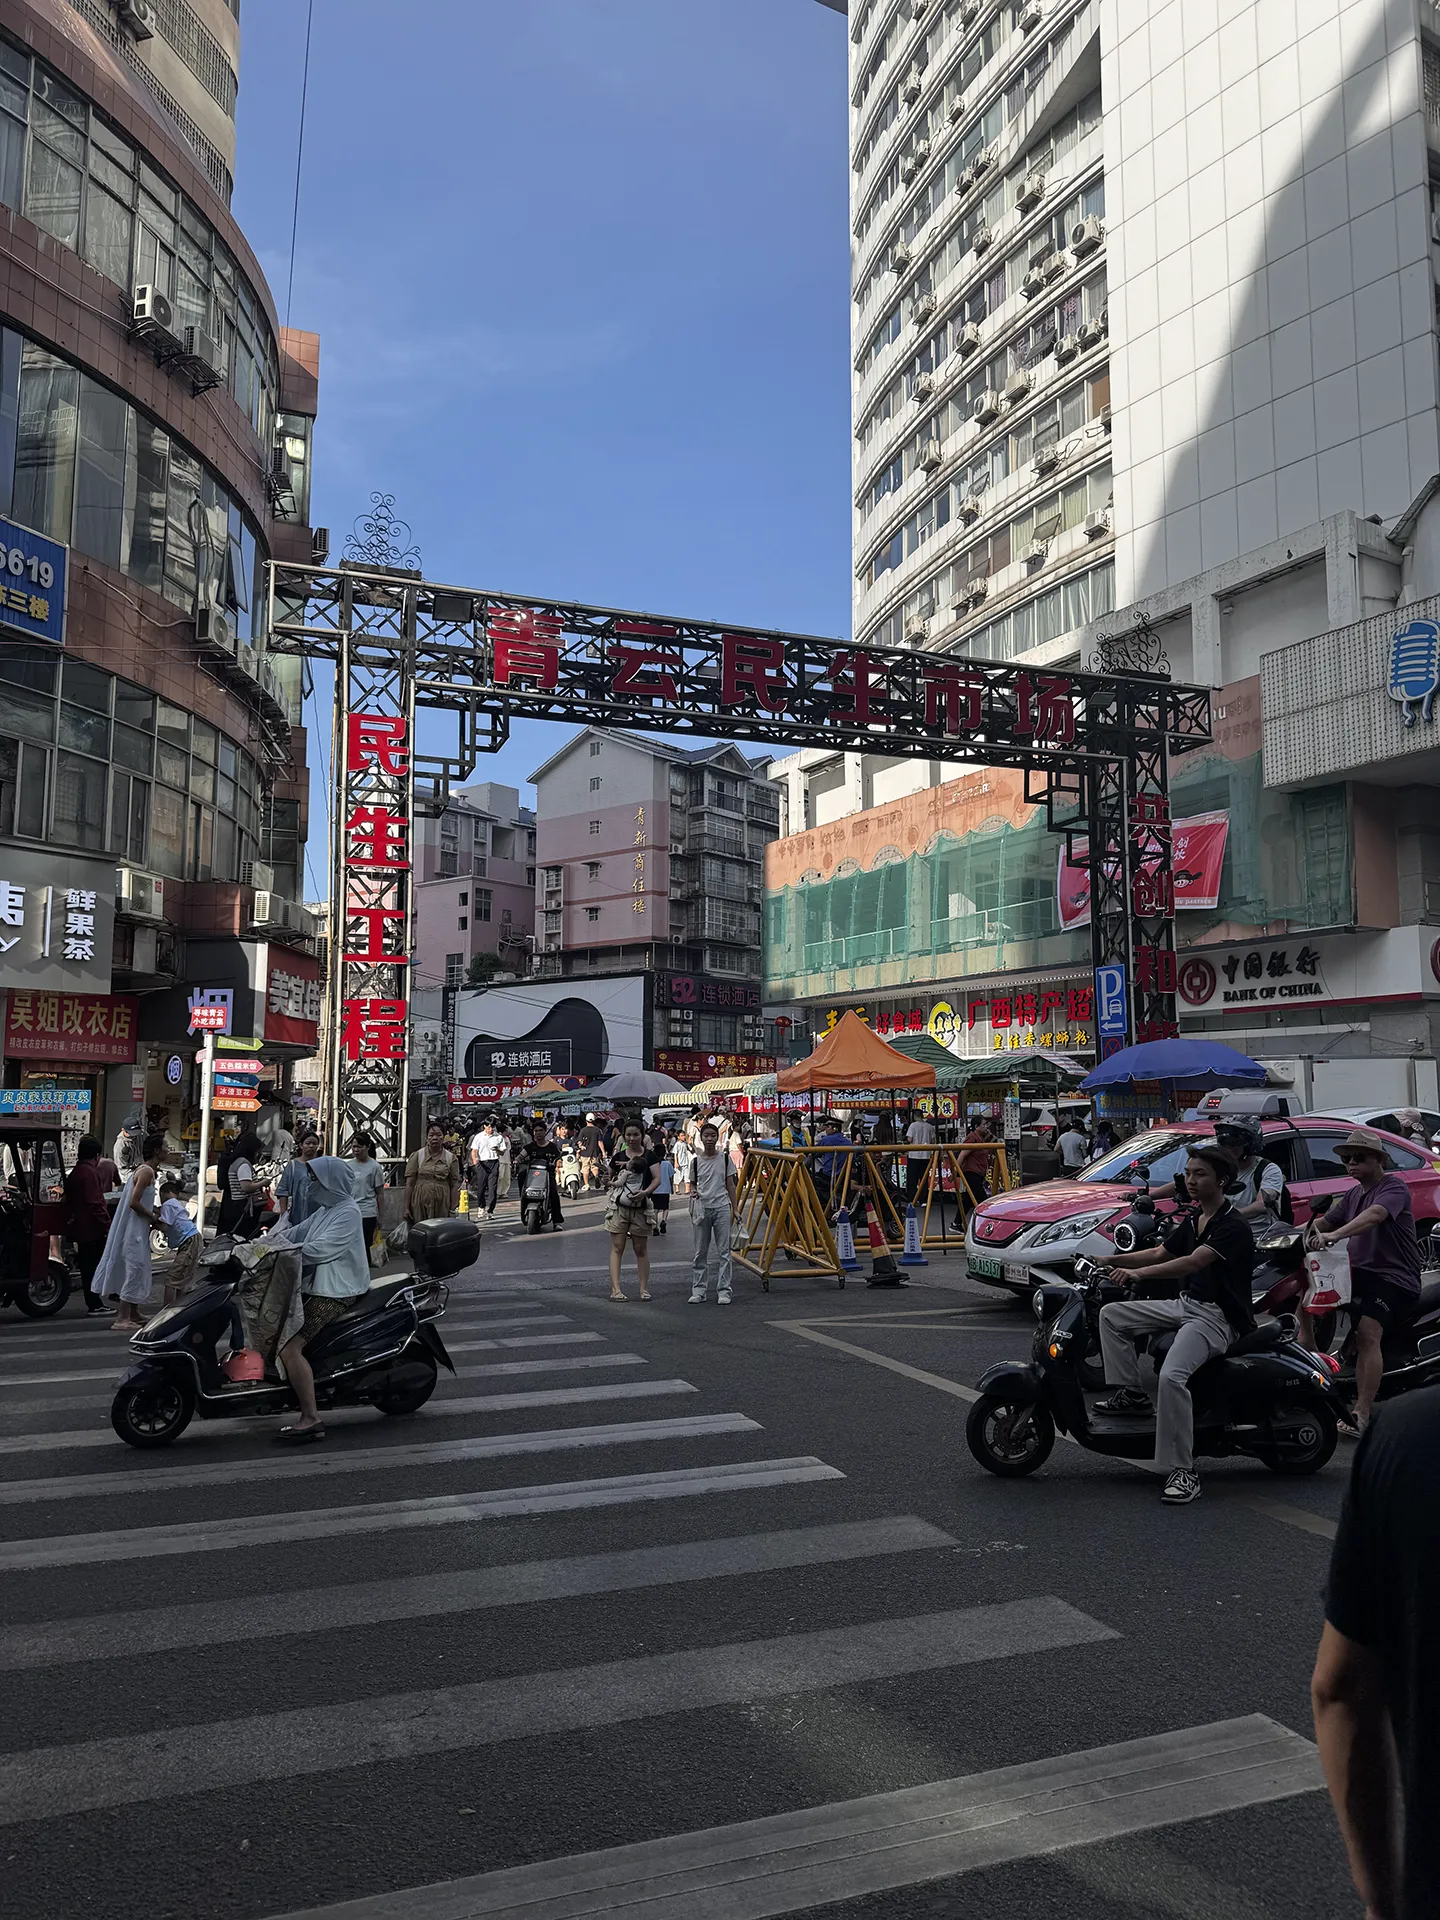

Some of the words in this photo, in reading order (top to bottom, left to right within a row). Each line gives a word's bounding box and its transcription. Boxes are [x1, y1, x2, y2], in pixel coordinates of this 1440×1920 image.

[486, 606, 1076, 743] 青云民生市场
[341, 712, 409, 1060] 民生工程
[64, 888, 97, 961] 鲜果茶
[1222, 946, 1321, 985] 中国银行
[967, 990, 1093, 1030] 广西特产超
[1100, 969, 1122, 1021] P
[1223, 988, 1258, 1002] BANK
[1260, 986, 1277, 999] OF
[1278, 982, 1323, 998] CHINA
[10, 991, 132, 1039] 吴姐改衣店
[193, 1008, 225, 1017] 寻味青云
[193, 1017, 225, 1026] 小吃市集
[876, 1009, 923, 1035] 好食城
[508, 1050, 551, 1067] 连锁酒店
